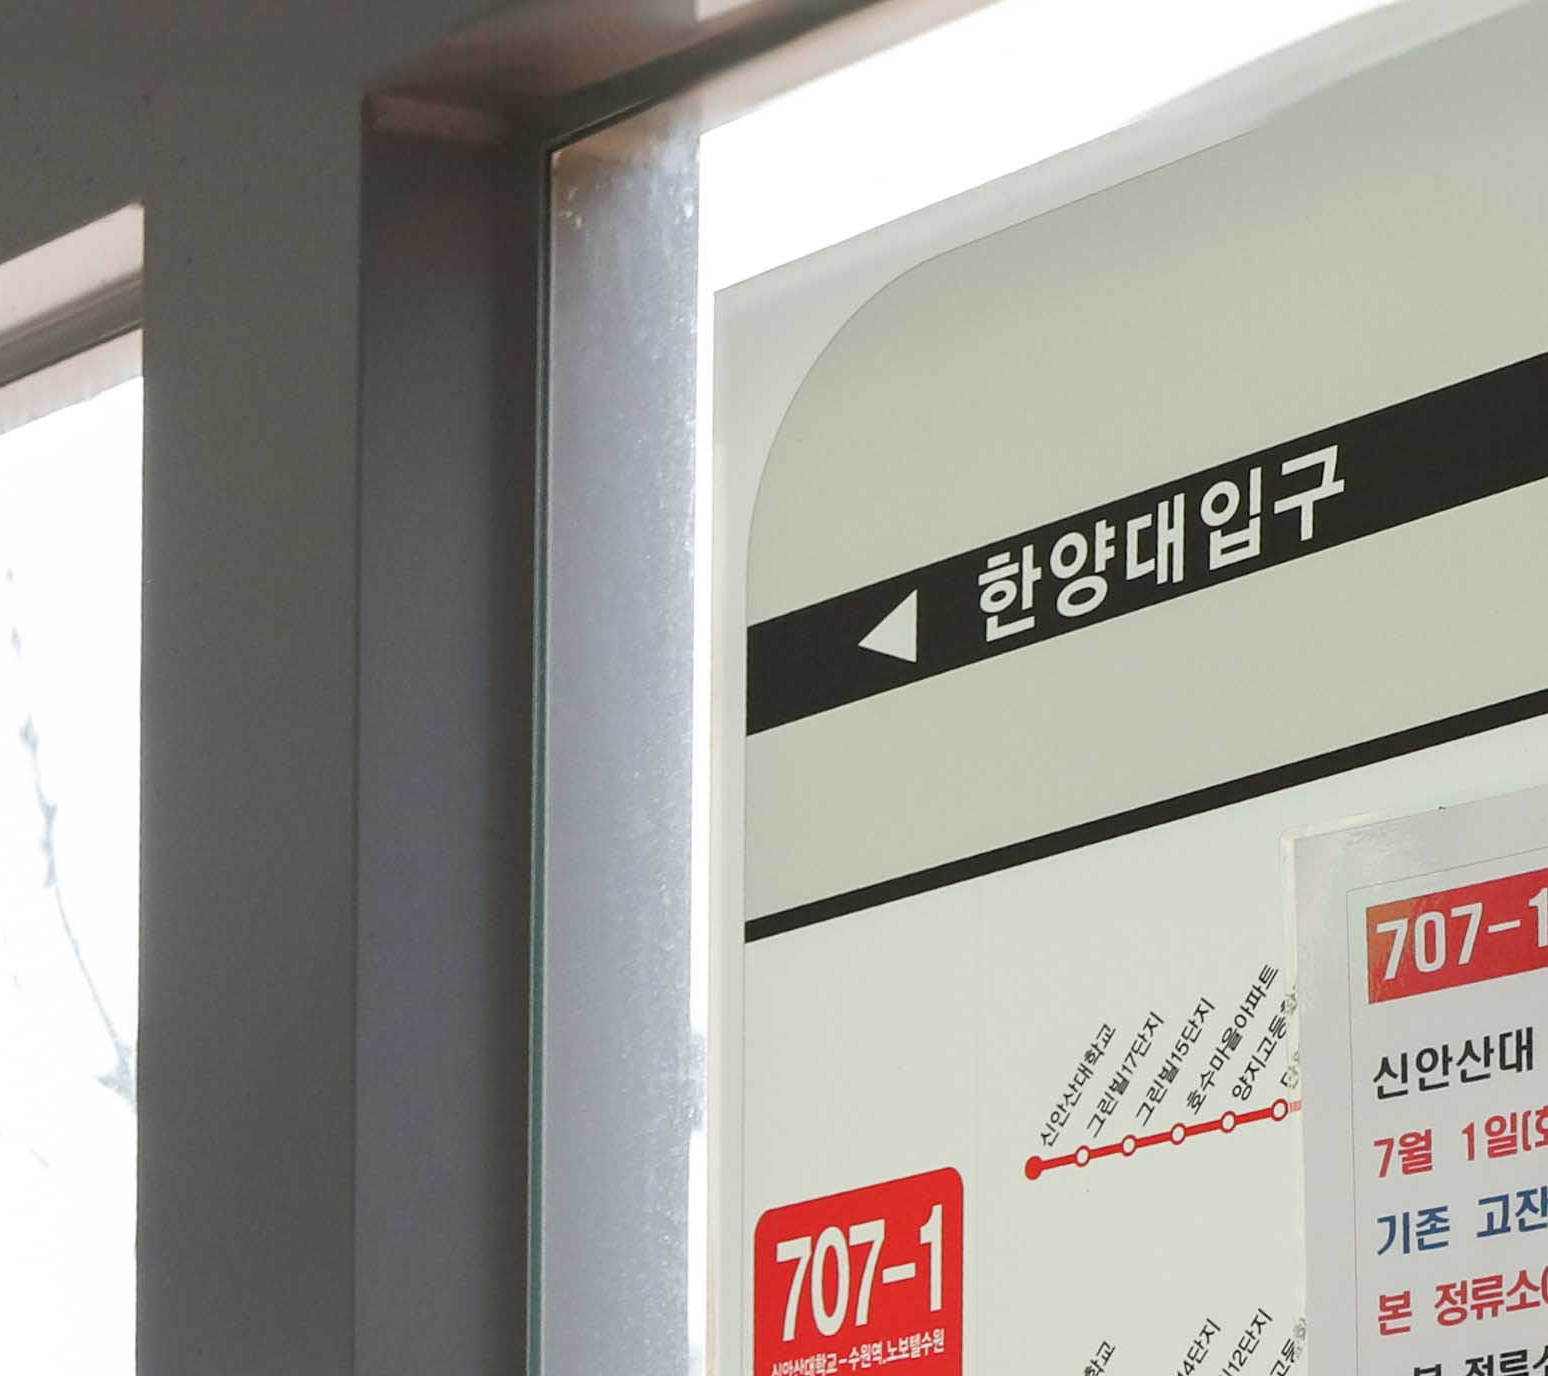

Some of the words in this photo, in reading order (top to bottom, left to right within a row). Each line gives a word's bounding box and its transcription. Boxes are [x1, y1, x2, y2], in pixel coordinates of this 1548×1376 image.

[978, 444, 1345, 644] 한양대입구
[1377, 888, 1548, 981] 707-1
[1040, 1023, 1116, 1149] 신안산대학교
[1086, 1012, 1165, 1139] 그린빌17단지
[1135, 998, 1215, 1127] 그린빌15단지
[1185, 964, 1278, 1113] 호수마을아파트
[1373, 1027, 1533, 1100] 신안산대
[1373, 1129, 1433, 1178] 7월
[776, 1204, 943, 1342] 707-1
[1377, 1206, 1450, 1255] 기존
[1378, 1291, 1412, 1335] 본
